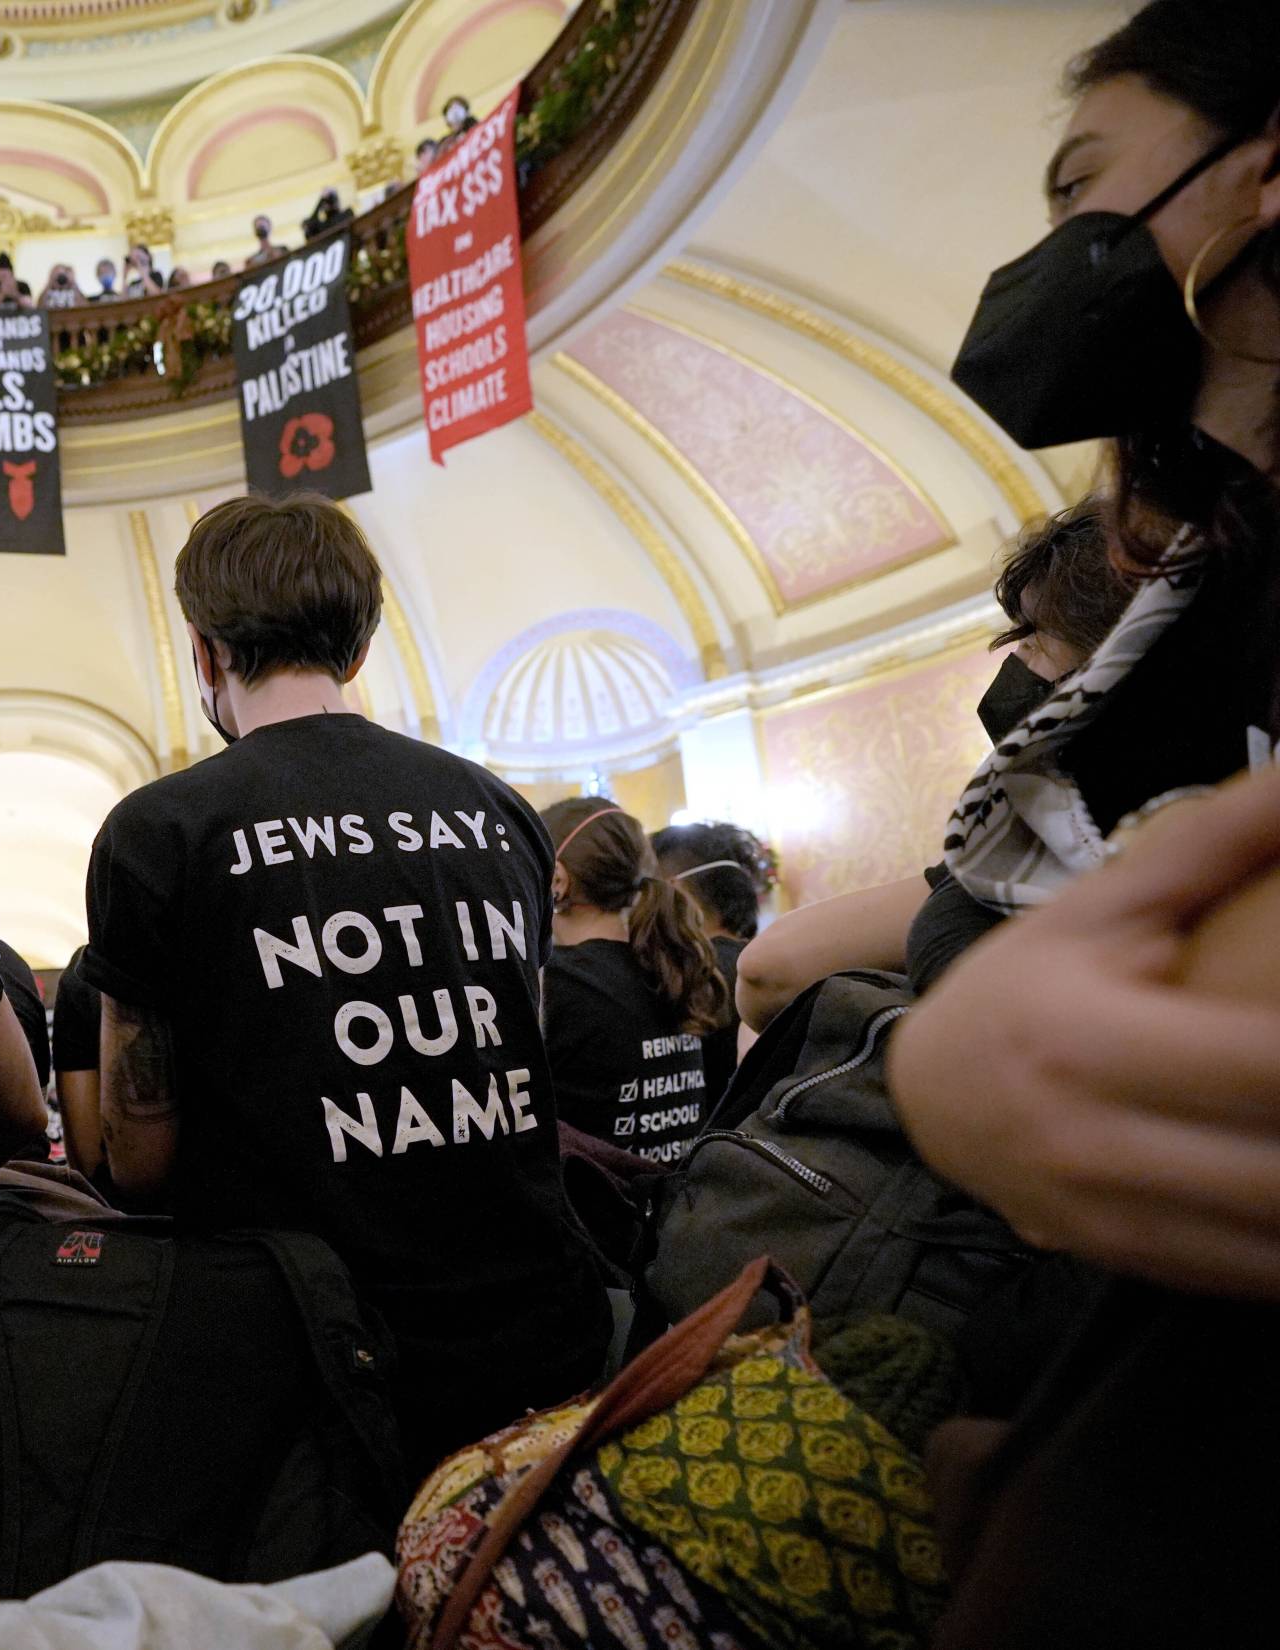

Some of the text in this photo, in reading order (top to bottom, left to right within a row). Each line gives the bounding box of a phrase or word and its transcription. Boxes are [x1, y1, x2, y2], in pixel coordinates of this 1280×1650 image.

[425, 285, 504, 353] HOUSING
[425, 325, 508, 392] SCHOOLS
[428, 368, 508, 432] CLIMATE
[229, 810, 510, 875] JEWS SAY:
[253, 900, 527, 989] NOT IN
[334, 985, 503, 1066] OUR
[320, 1068, 538, 1163] NAME
